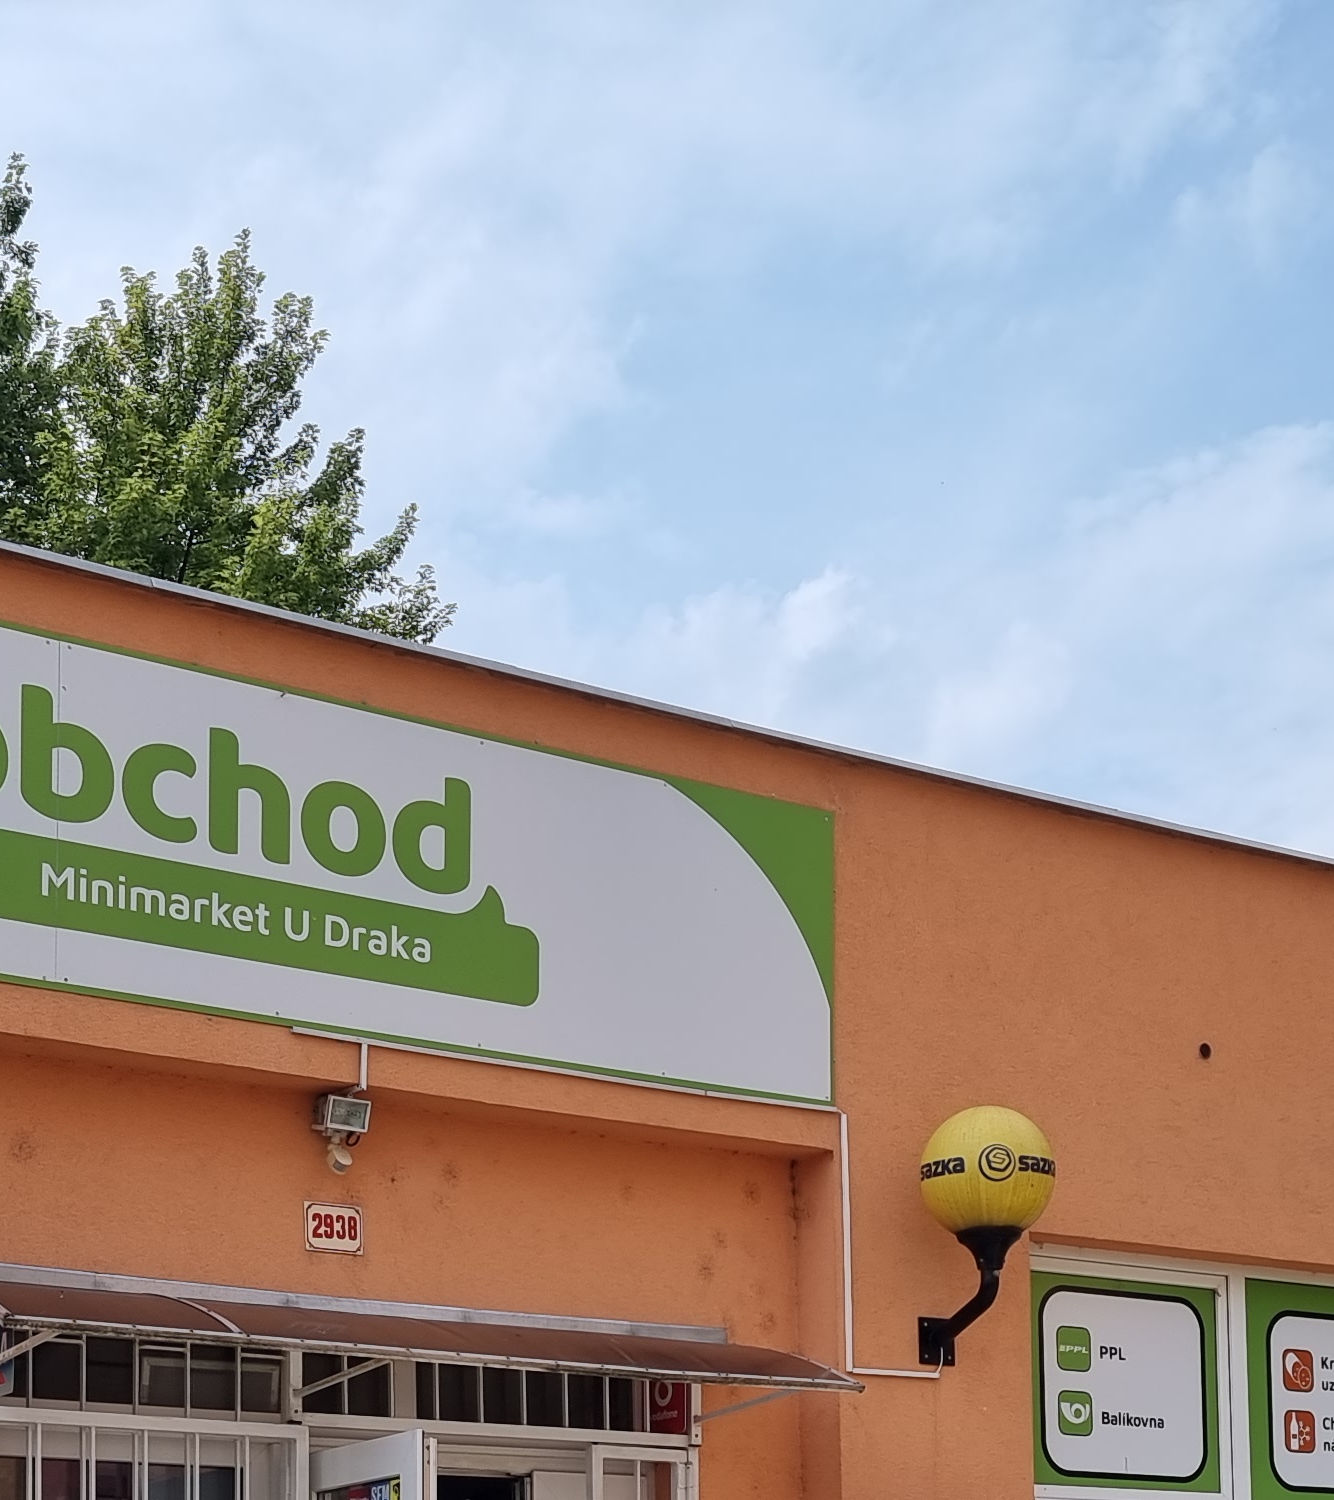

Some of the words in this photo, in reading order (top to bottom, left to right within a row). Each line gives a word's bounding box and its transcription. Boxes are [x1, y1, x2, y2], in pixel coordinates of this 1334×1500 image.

[41, 862, 270, 936] Minimarket
[284, 906, 310, 942] U
[324, 913, 431, 963] Draka
[312, 1212, 358, 1241] 2938
[1099, 1345, 1127, 1361] PPL
[1101, 1411, 1165, 1429] Balíkovna
